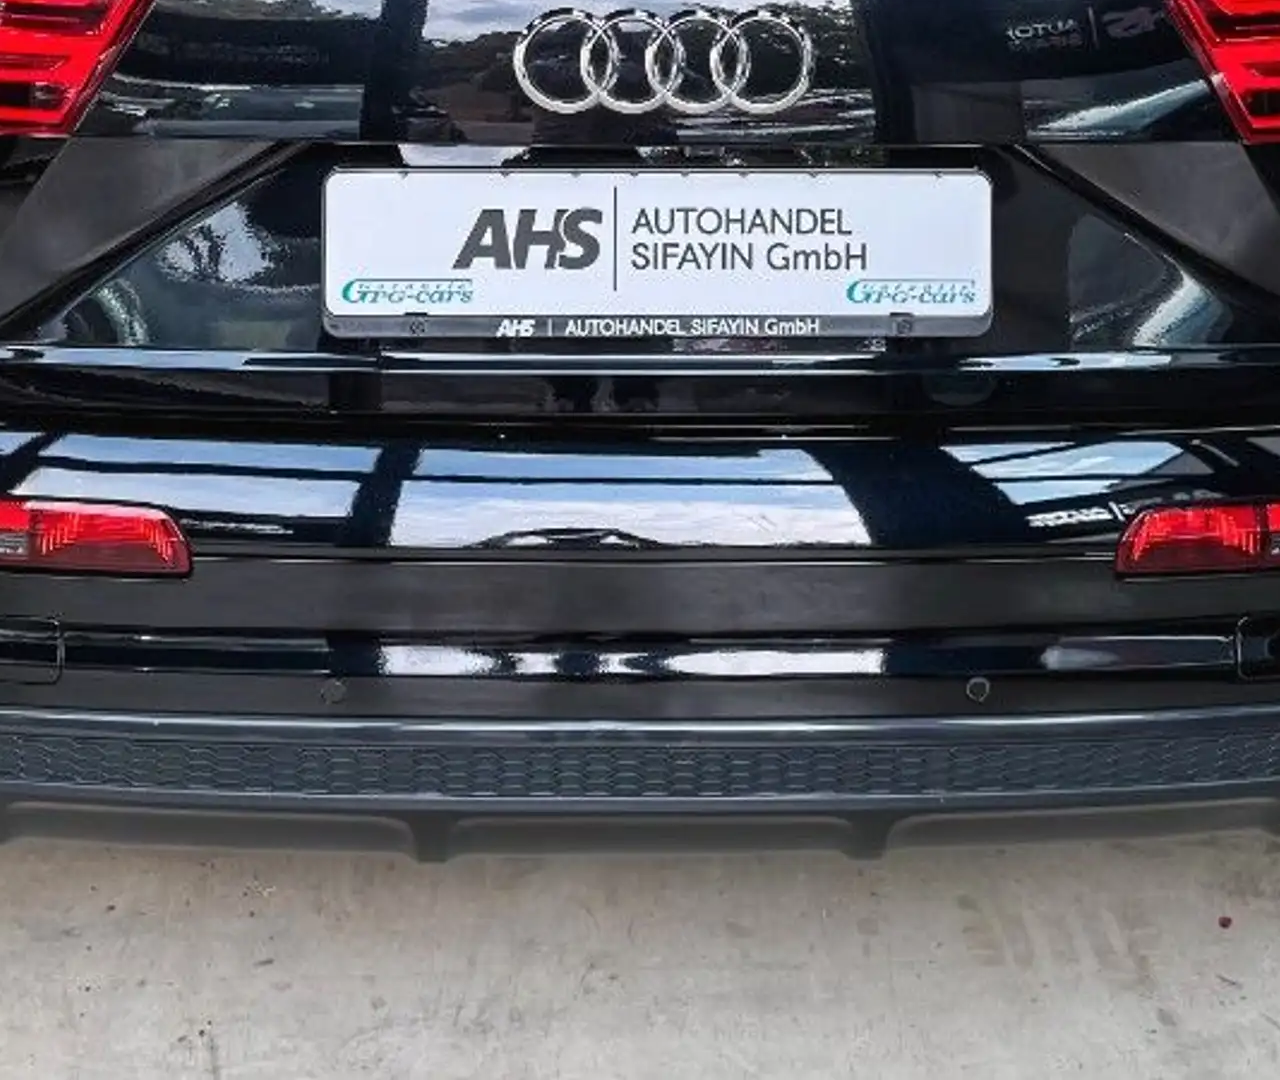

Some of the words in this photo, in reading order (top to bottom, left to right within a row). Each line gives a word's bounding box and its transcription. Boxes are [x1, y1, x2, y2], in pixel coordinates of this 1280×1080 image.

[631, 208, 853, 235] AUTOHANDEL
[452, 207, 603, 270] AHS
[631, 242, 754, 271] SIFAYIN
[766, 242, 868, 271] GmbH
[496, 319, 534, 337] AHS
[565, 319, 686, 336] AUTOHANDEL
[690, 319, 759, 336] SIFAYIN
[764, 319, 820, 336] GmbH
